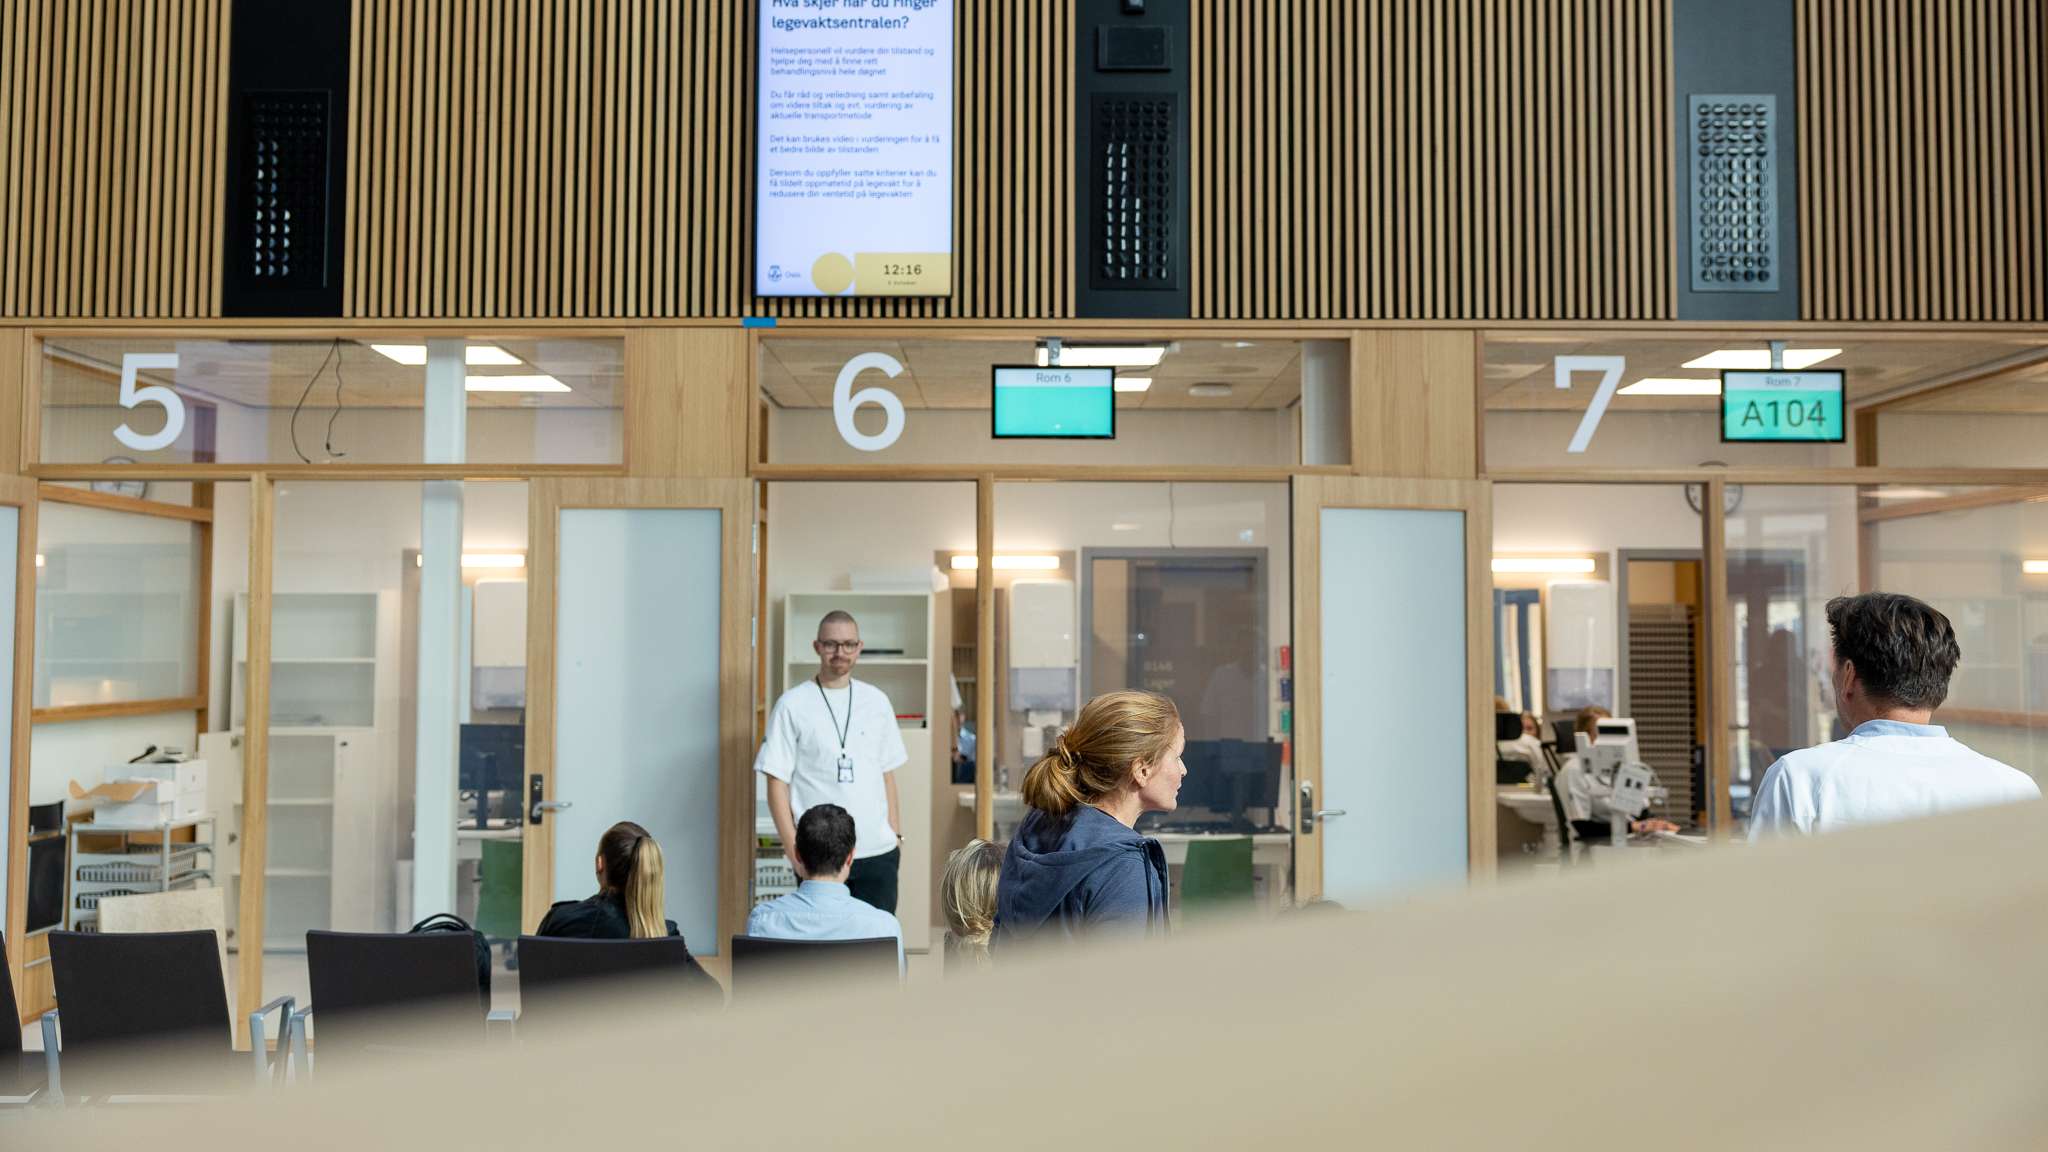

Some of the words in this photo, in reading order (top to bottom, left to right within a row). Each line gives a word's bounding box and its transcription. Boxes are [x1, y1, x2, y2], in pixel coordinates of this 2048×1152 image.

[893, 0, 937, 10] ringer
[772, 16, 909, 31] legevaktsentralen?
[813, 92, 823, 100] og
[884, 264, 922, 276] 12:16
[1036, 373, 1061, 383] Rom
[1064, 373, 1072, 383] 6
[113, 353, 185, 451] 5
[833, 352, 905, 451] 6
[1554, 356, 1626, 453] 7
[1741, 400, 1826, 427] A104
